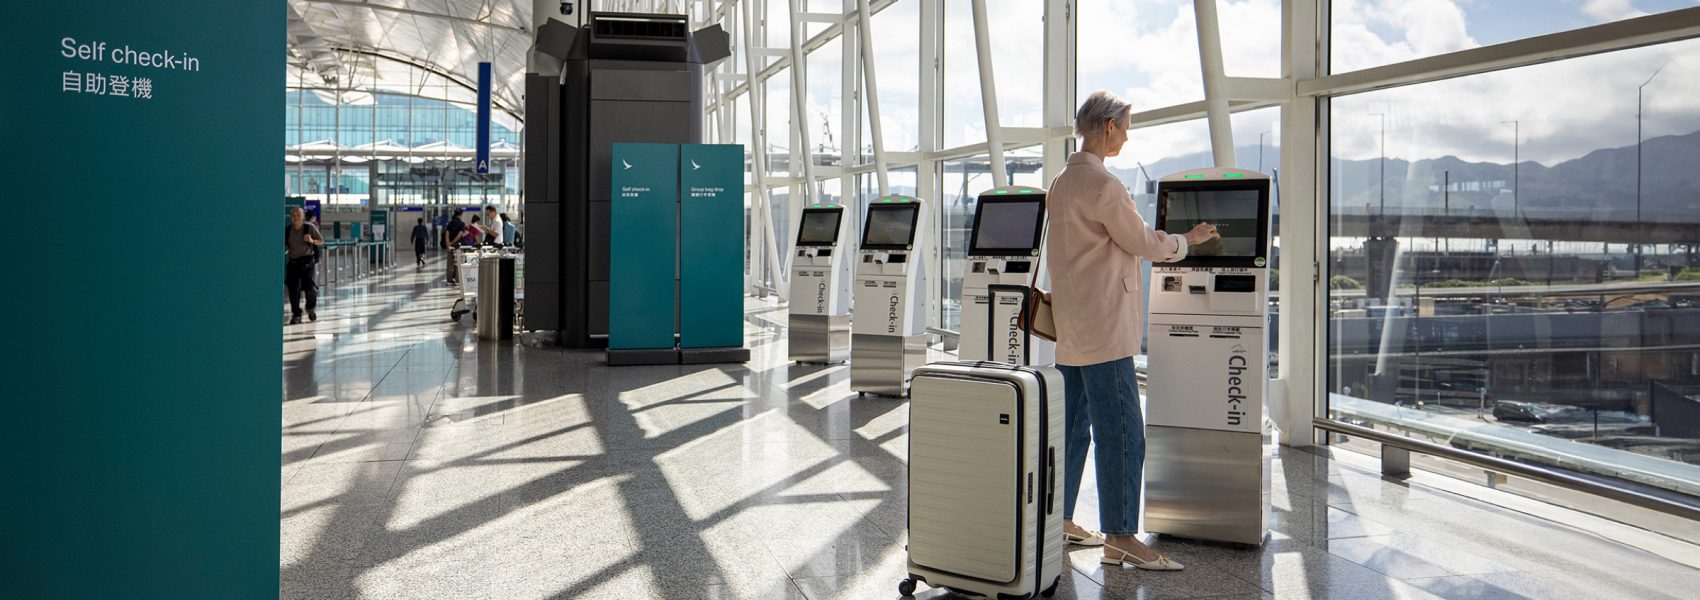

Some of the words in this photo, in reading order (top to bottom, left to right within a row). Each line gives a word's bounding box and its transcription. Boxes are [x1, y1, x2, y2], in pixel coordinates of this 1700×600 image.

[61, 37, 106, 61] Self
[111, 45, 200, 72] check-in
[62, 70, 153, 99] 自助登機
[478, 160, 488, 170] A
[817, 283, 826, 313] Check-in
[888, 296, 898, 333] Check-in
[1227, 355, 1247, 426] Check-in
